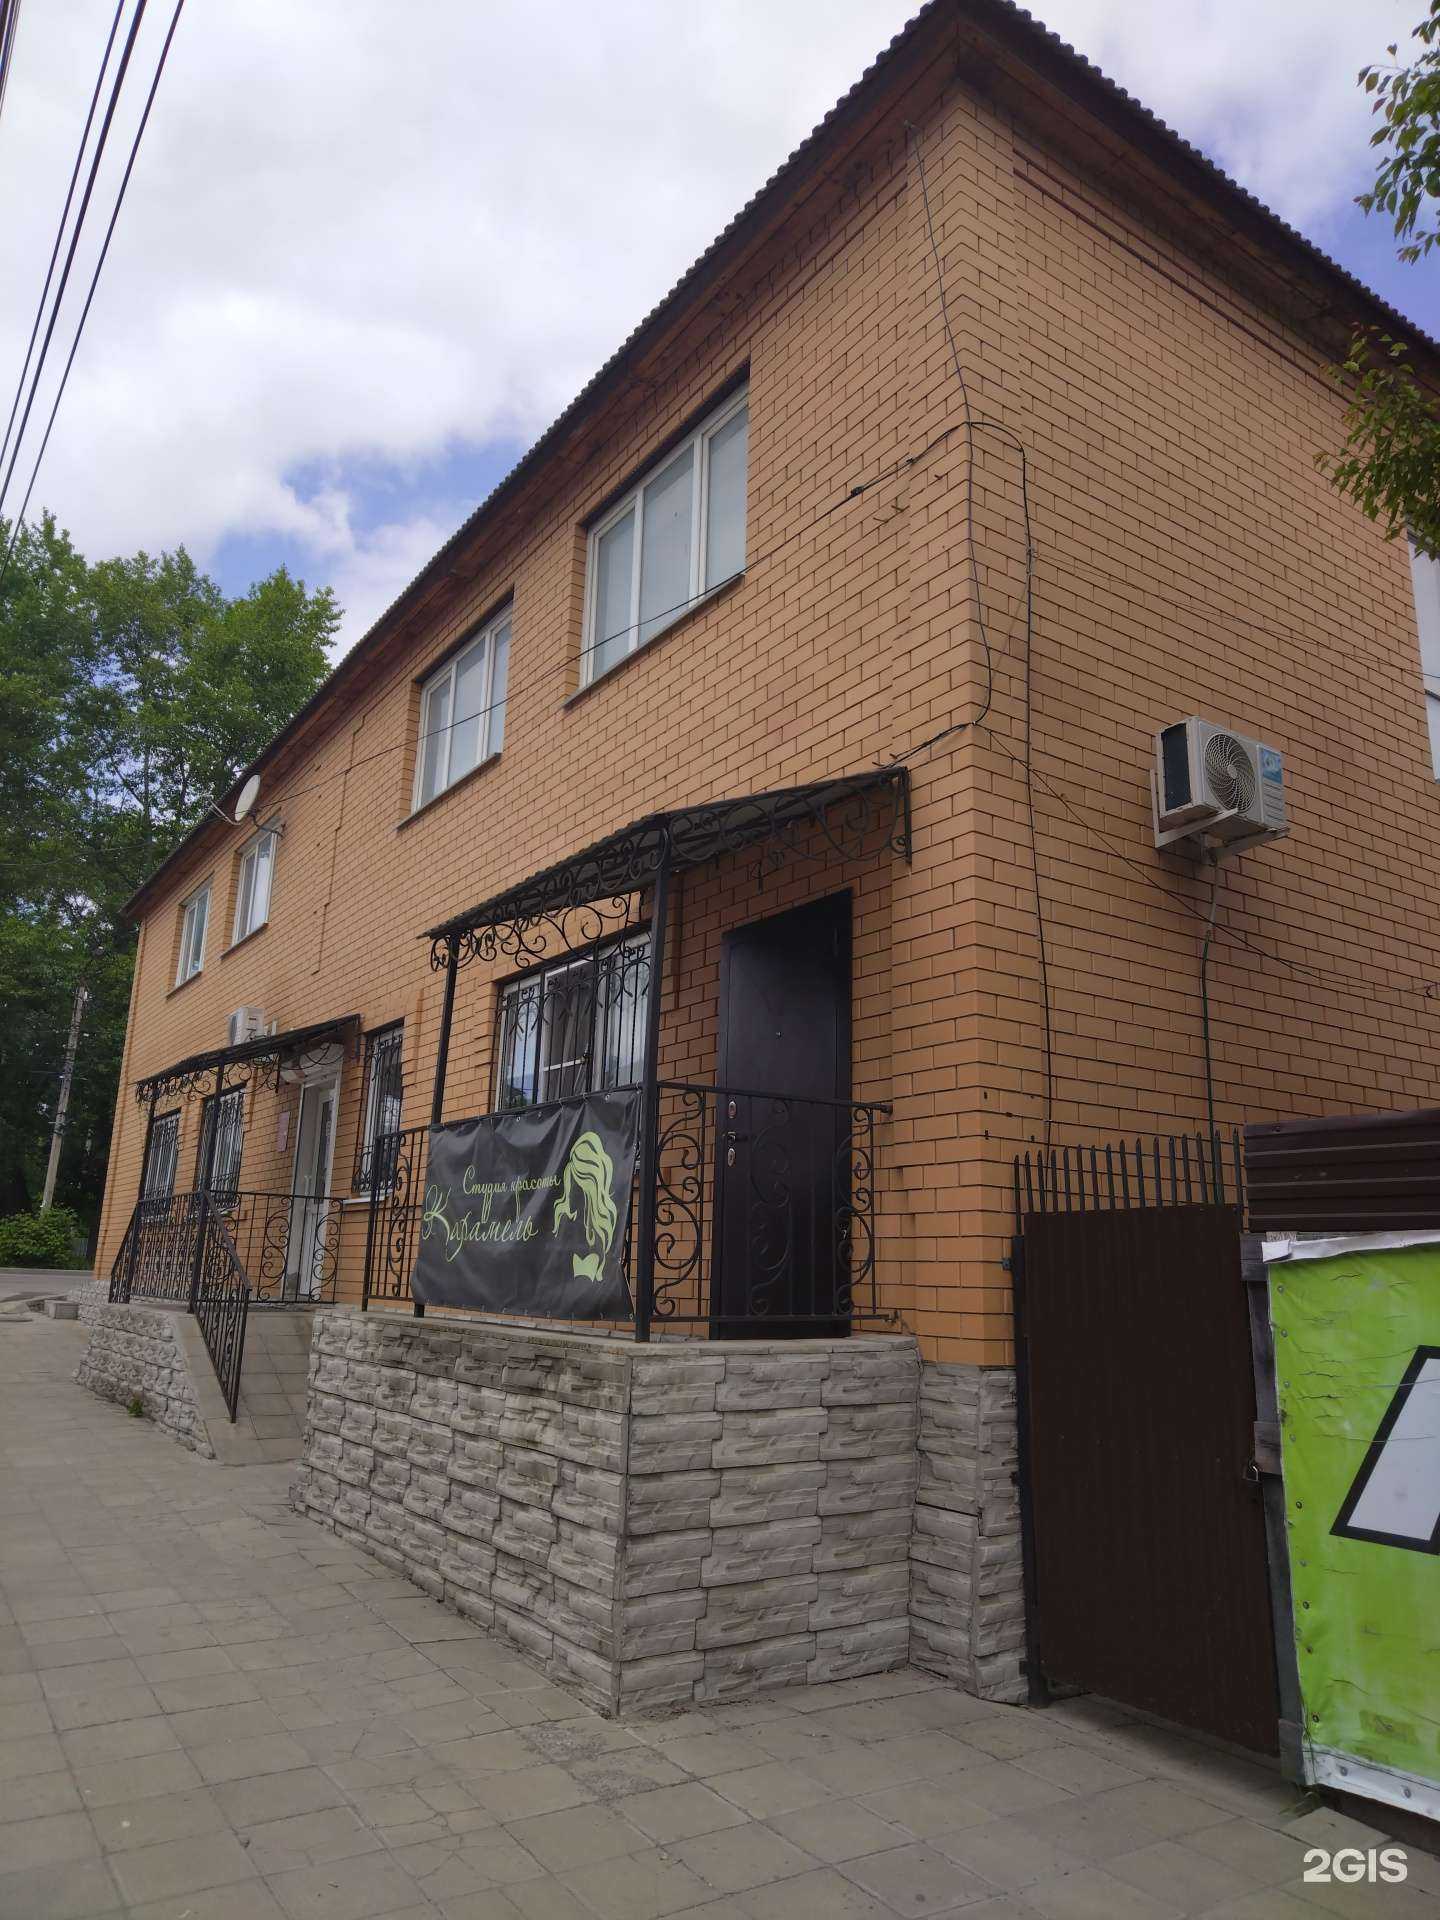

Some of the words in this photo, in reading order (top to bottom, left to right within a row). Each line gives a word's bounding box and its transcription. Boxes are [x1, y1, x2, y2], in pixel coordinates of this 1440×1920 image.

[422, 1184, 539, 1262] Карамель
[463, 1164, 508, 1223] Студия
[510, 1175, 561, 1223] красоты
